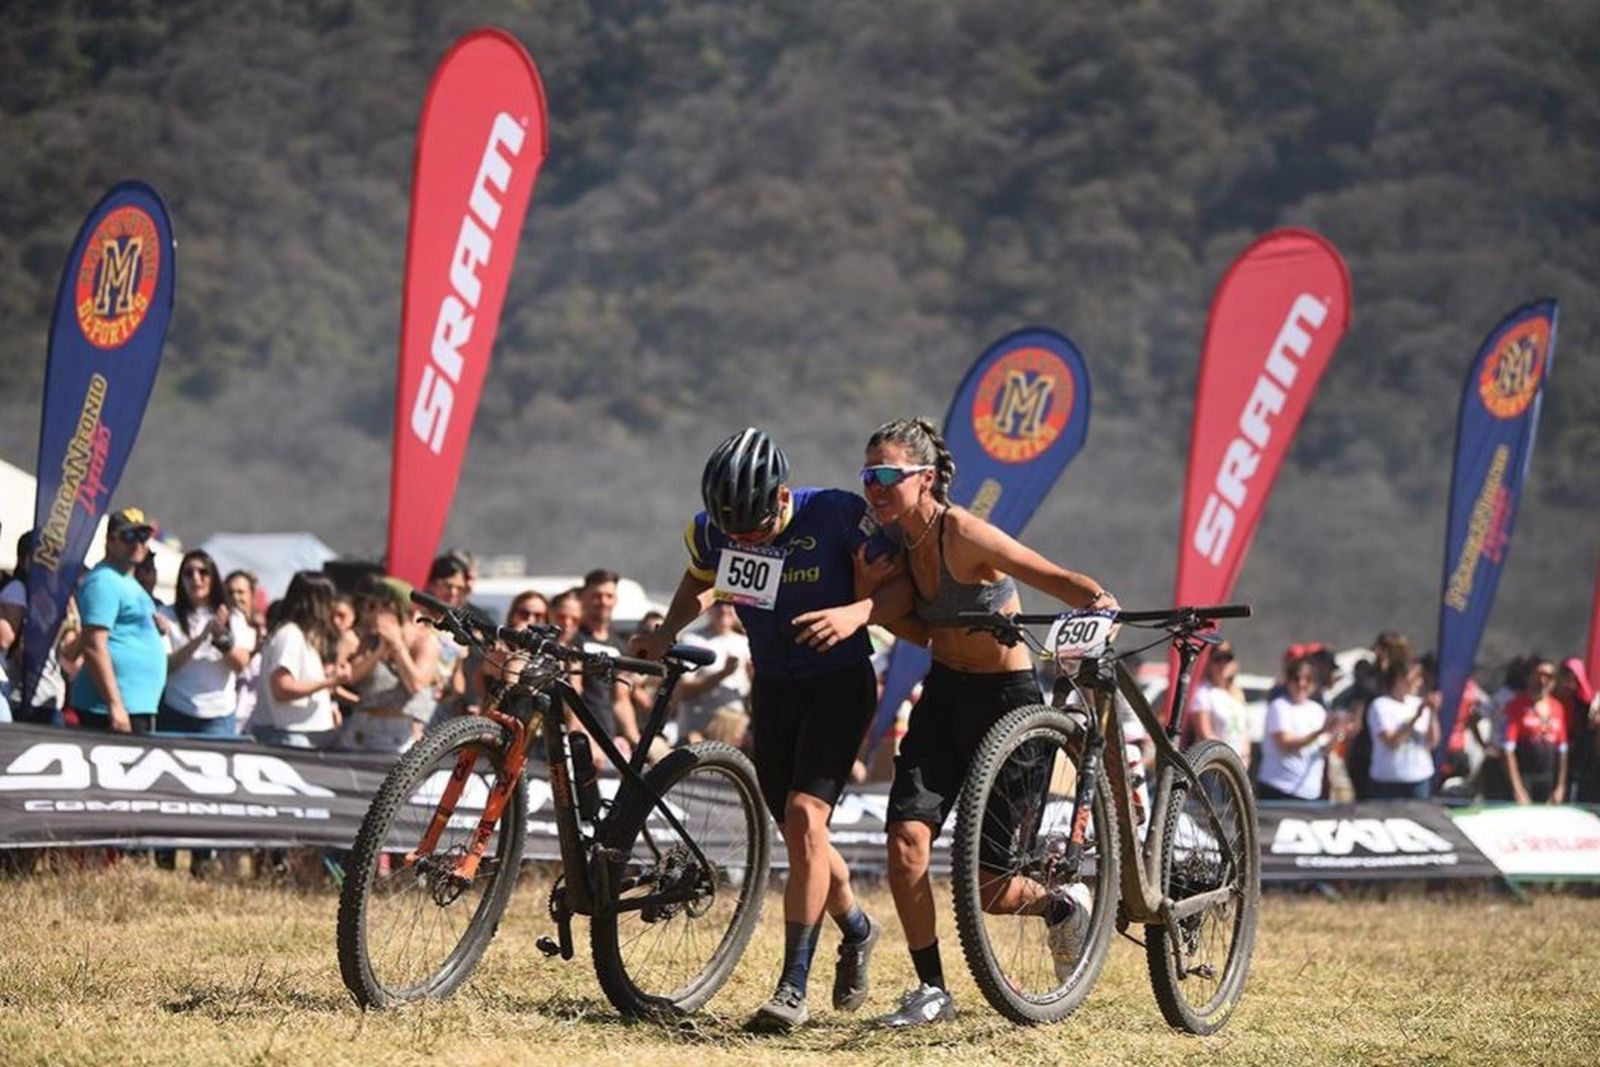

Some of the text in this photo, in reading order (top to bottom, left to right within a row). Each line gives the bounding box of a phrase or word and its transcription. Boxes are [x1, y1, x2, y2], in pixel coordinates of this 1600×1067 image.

[94, 236, 143, 316] M
[411, 111, 526, 455] SRAM
[995, 369, 1056, 438] M
[1193, 293, 1329, 566] SRAM
[727, 556, 770, 591] 590
[1056, 620, 1099, 645] 590
